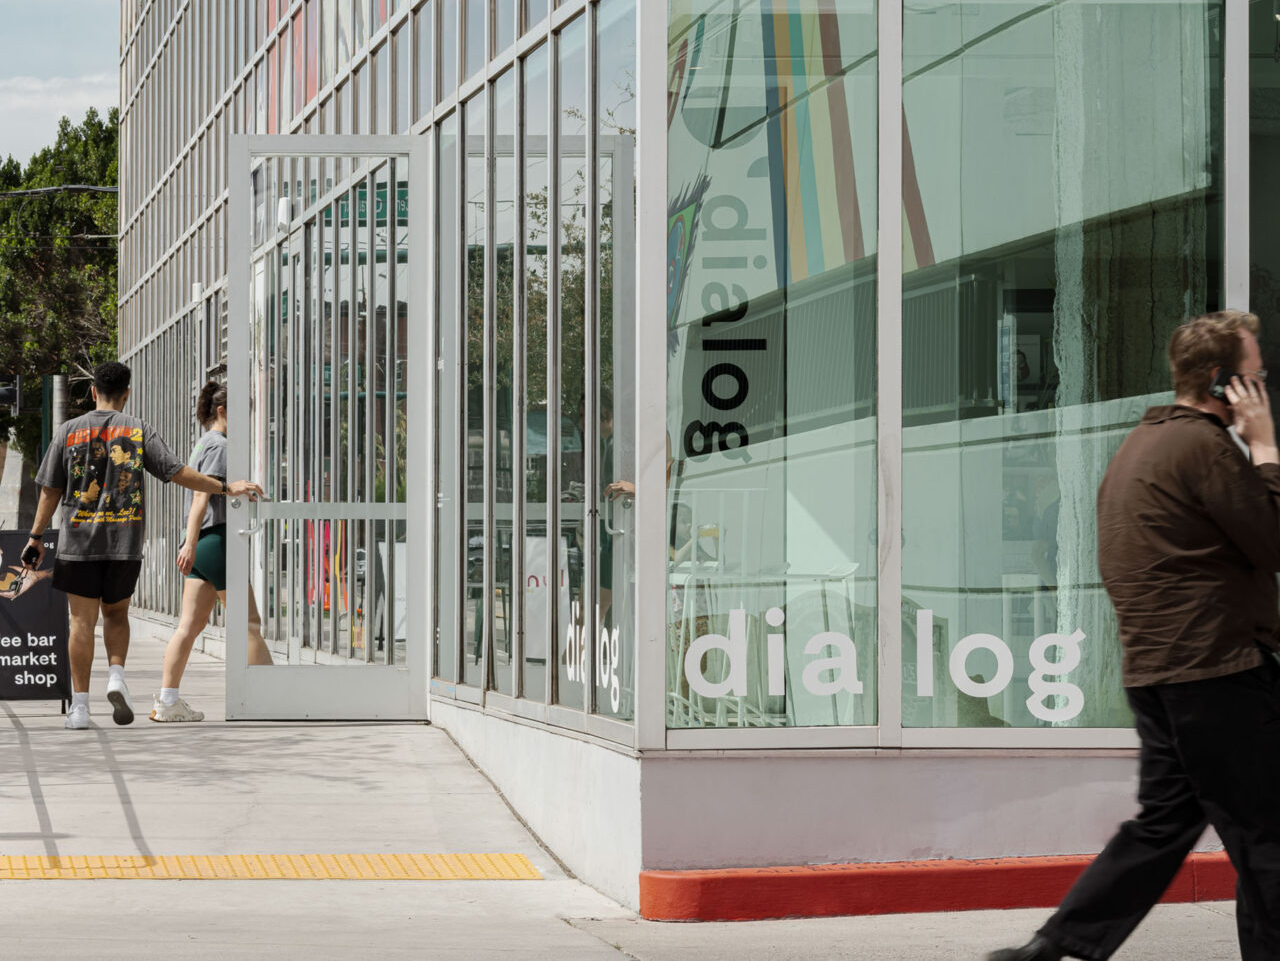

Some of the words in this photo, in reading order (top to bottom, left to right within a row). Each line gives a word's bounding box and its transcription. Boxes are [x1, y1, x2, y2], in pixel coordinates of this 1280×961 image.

[684, 194, 767, 464] dialog
[130, 427, 143, 443] 2
[27, 633, 56, 647] bar
[14, 671, 58, 688] shop
